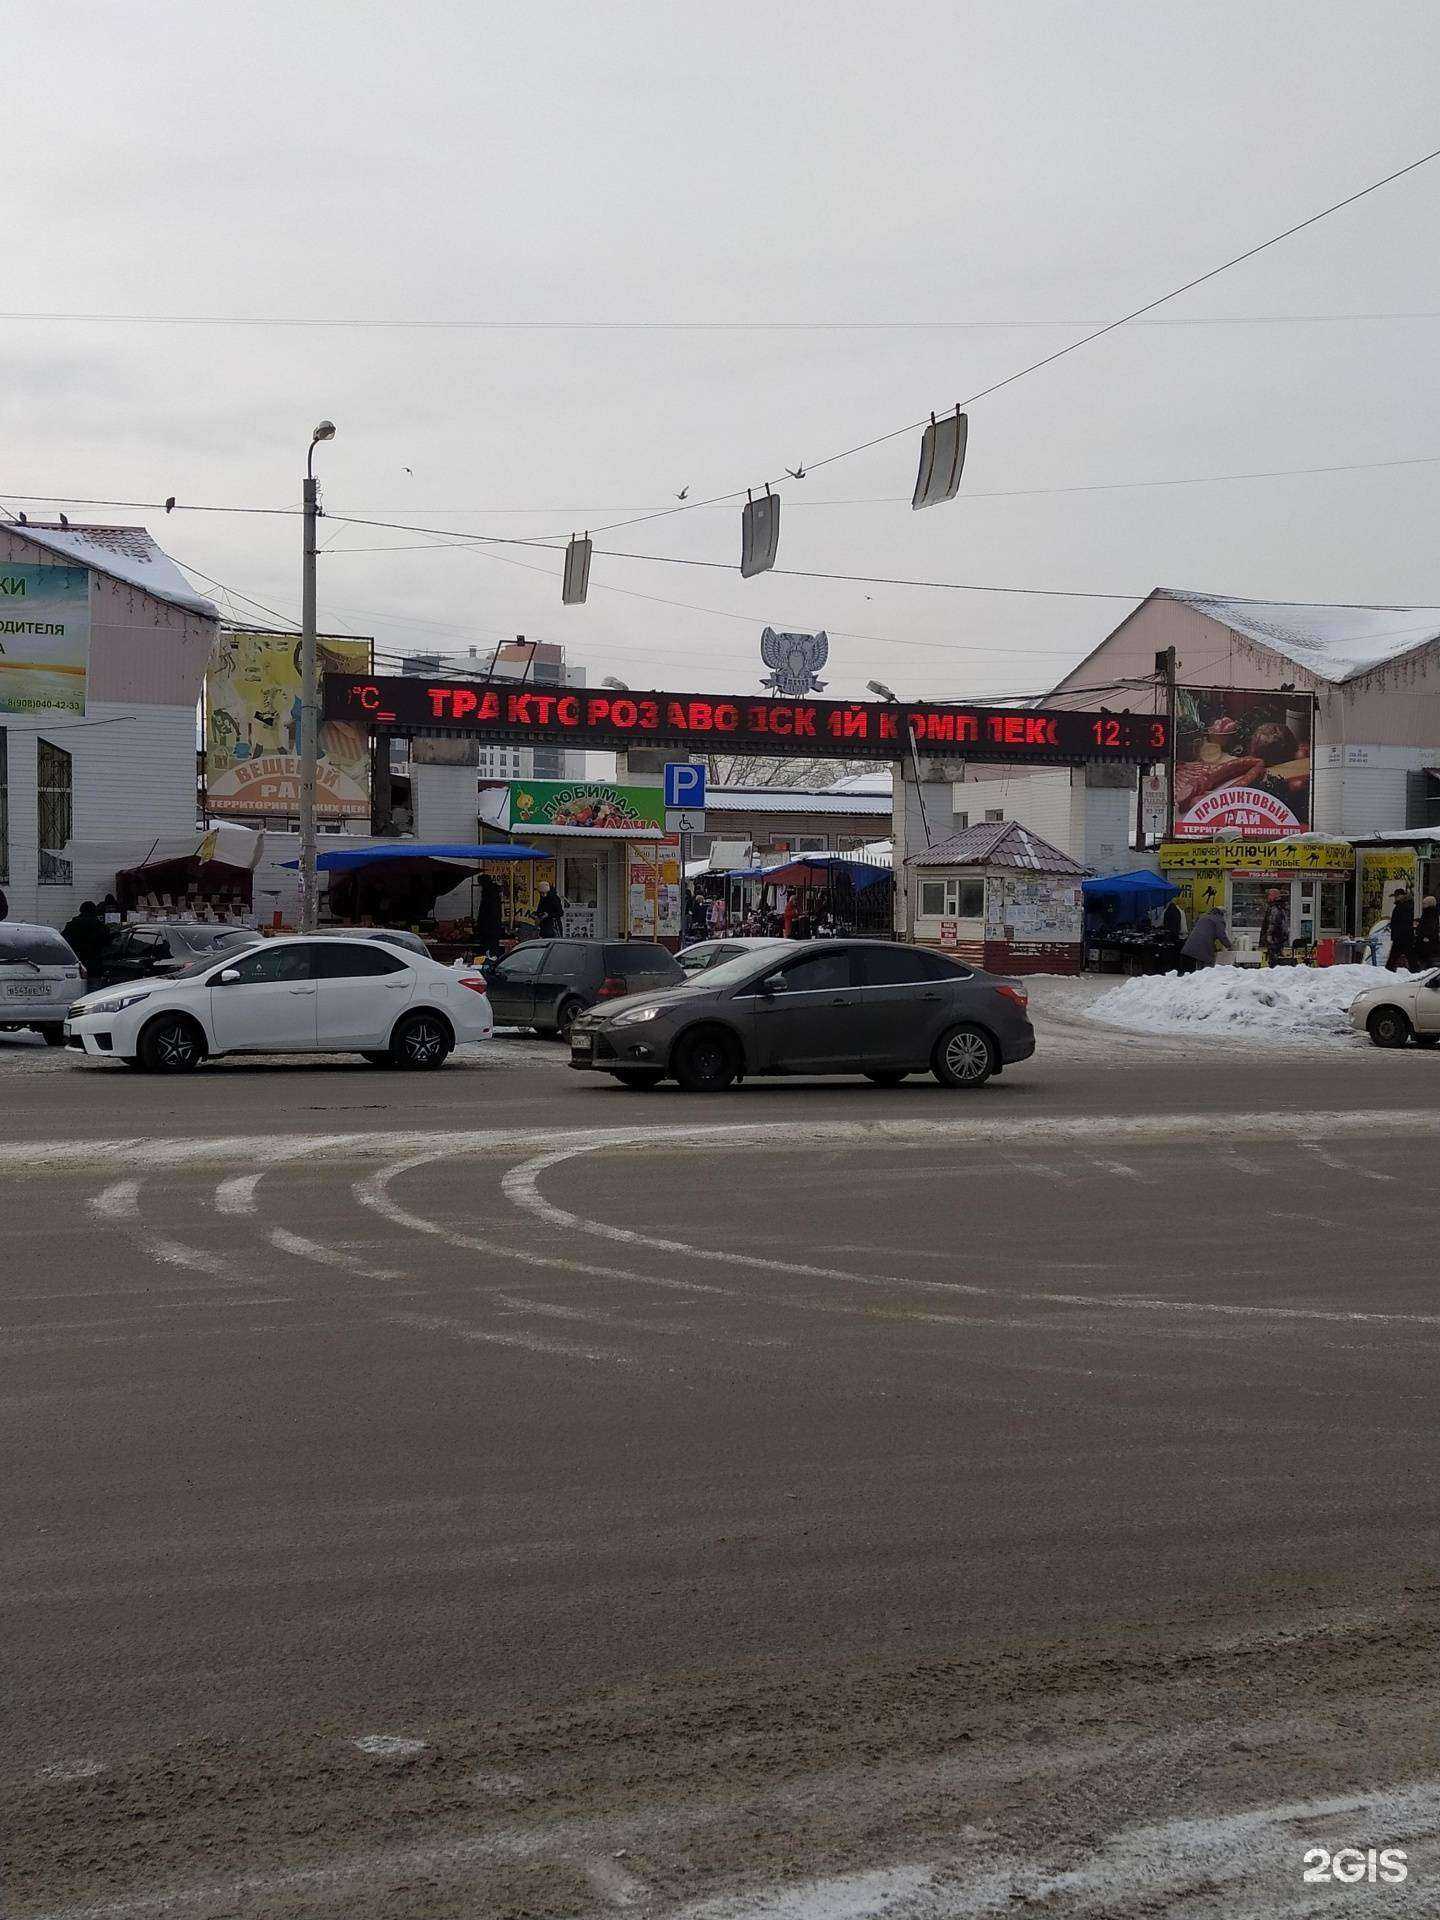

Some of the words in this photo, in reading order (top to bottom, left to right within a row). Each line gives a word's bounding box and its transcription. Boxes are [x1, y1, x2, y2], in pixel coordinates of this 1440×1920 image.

[210, 801, 287, 811] ТЕРРИТОРИЯ
[541, 783, 640, 820] ЛЮБИМАЯ
[1194, 791, 1290, 823] ПРОДУКТОВЫЙ
[1225, 810, 1261, 825] РАЙ
[1225, 845, 1277, 858] КЛЮЧИ
[1269, 858, 1300, 868] ЛЮБЫЕ
